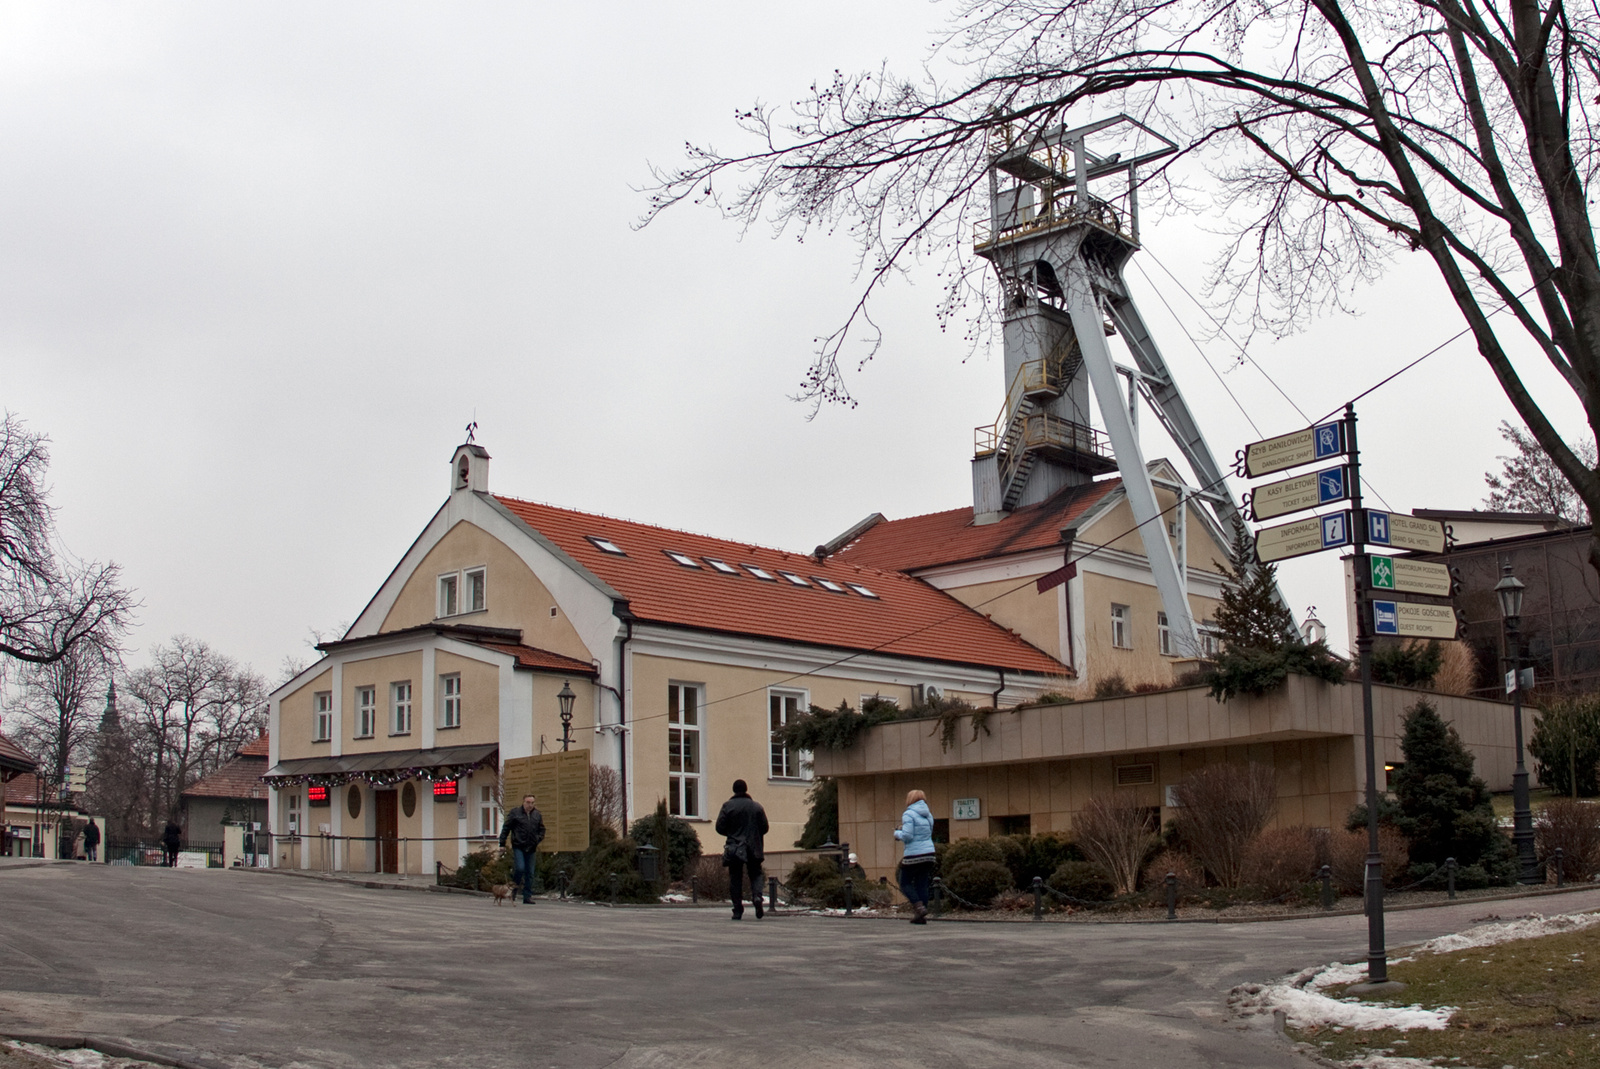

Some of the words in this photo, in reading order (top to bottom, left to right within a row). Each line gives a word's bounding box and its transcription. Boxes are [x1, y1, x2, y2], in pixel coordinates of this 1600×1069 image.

[1251, 446, 1267, 457] SZYB
[1268, 434, 1312, 451] DANIŁOWICZA
[1296, 450, 1313, 460] SHAFT
[1267, 486, 1282, 496] KASY
[1285, 477, 1316, 492] BILETOWE
[1282, 498, 1300, 508] TICKET
[1302, 494, 1317, 503] SALES
[1280, 522, 1319, 538] INFORMACJA
[1372, 517, 1386, 539] H
[1391, 518, 1408, 528] HOTEL
[1409, 521, 1427, 531] GRAND
[1429, 524, 1438, 533] SAL
[1286, 539, 1320, 552] INFORMATION
[1392, 534, 1406, 543] GRAND
[1417, 538, 1430, 547] HOTEL
[1395, 562, 1422, 572] SANATORIUM
[1422, 566, 1447, 575] PODZIEMNE
[1399, 606, 1420, 616] POKOJE
[1421, 607, 1450, 618] GOŚCINNE
[1400, 623, 1415, 631] GUEST
[1416, 624, 1433, 632] ROOMS
